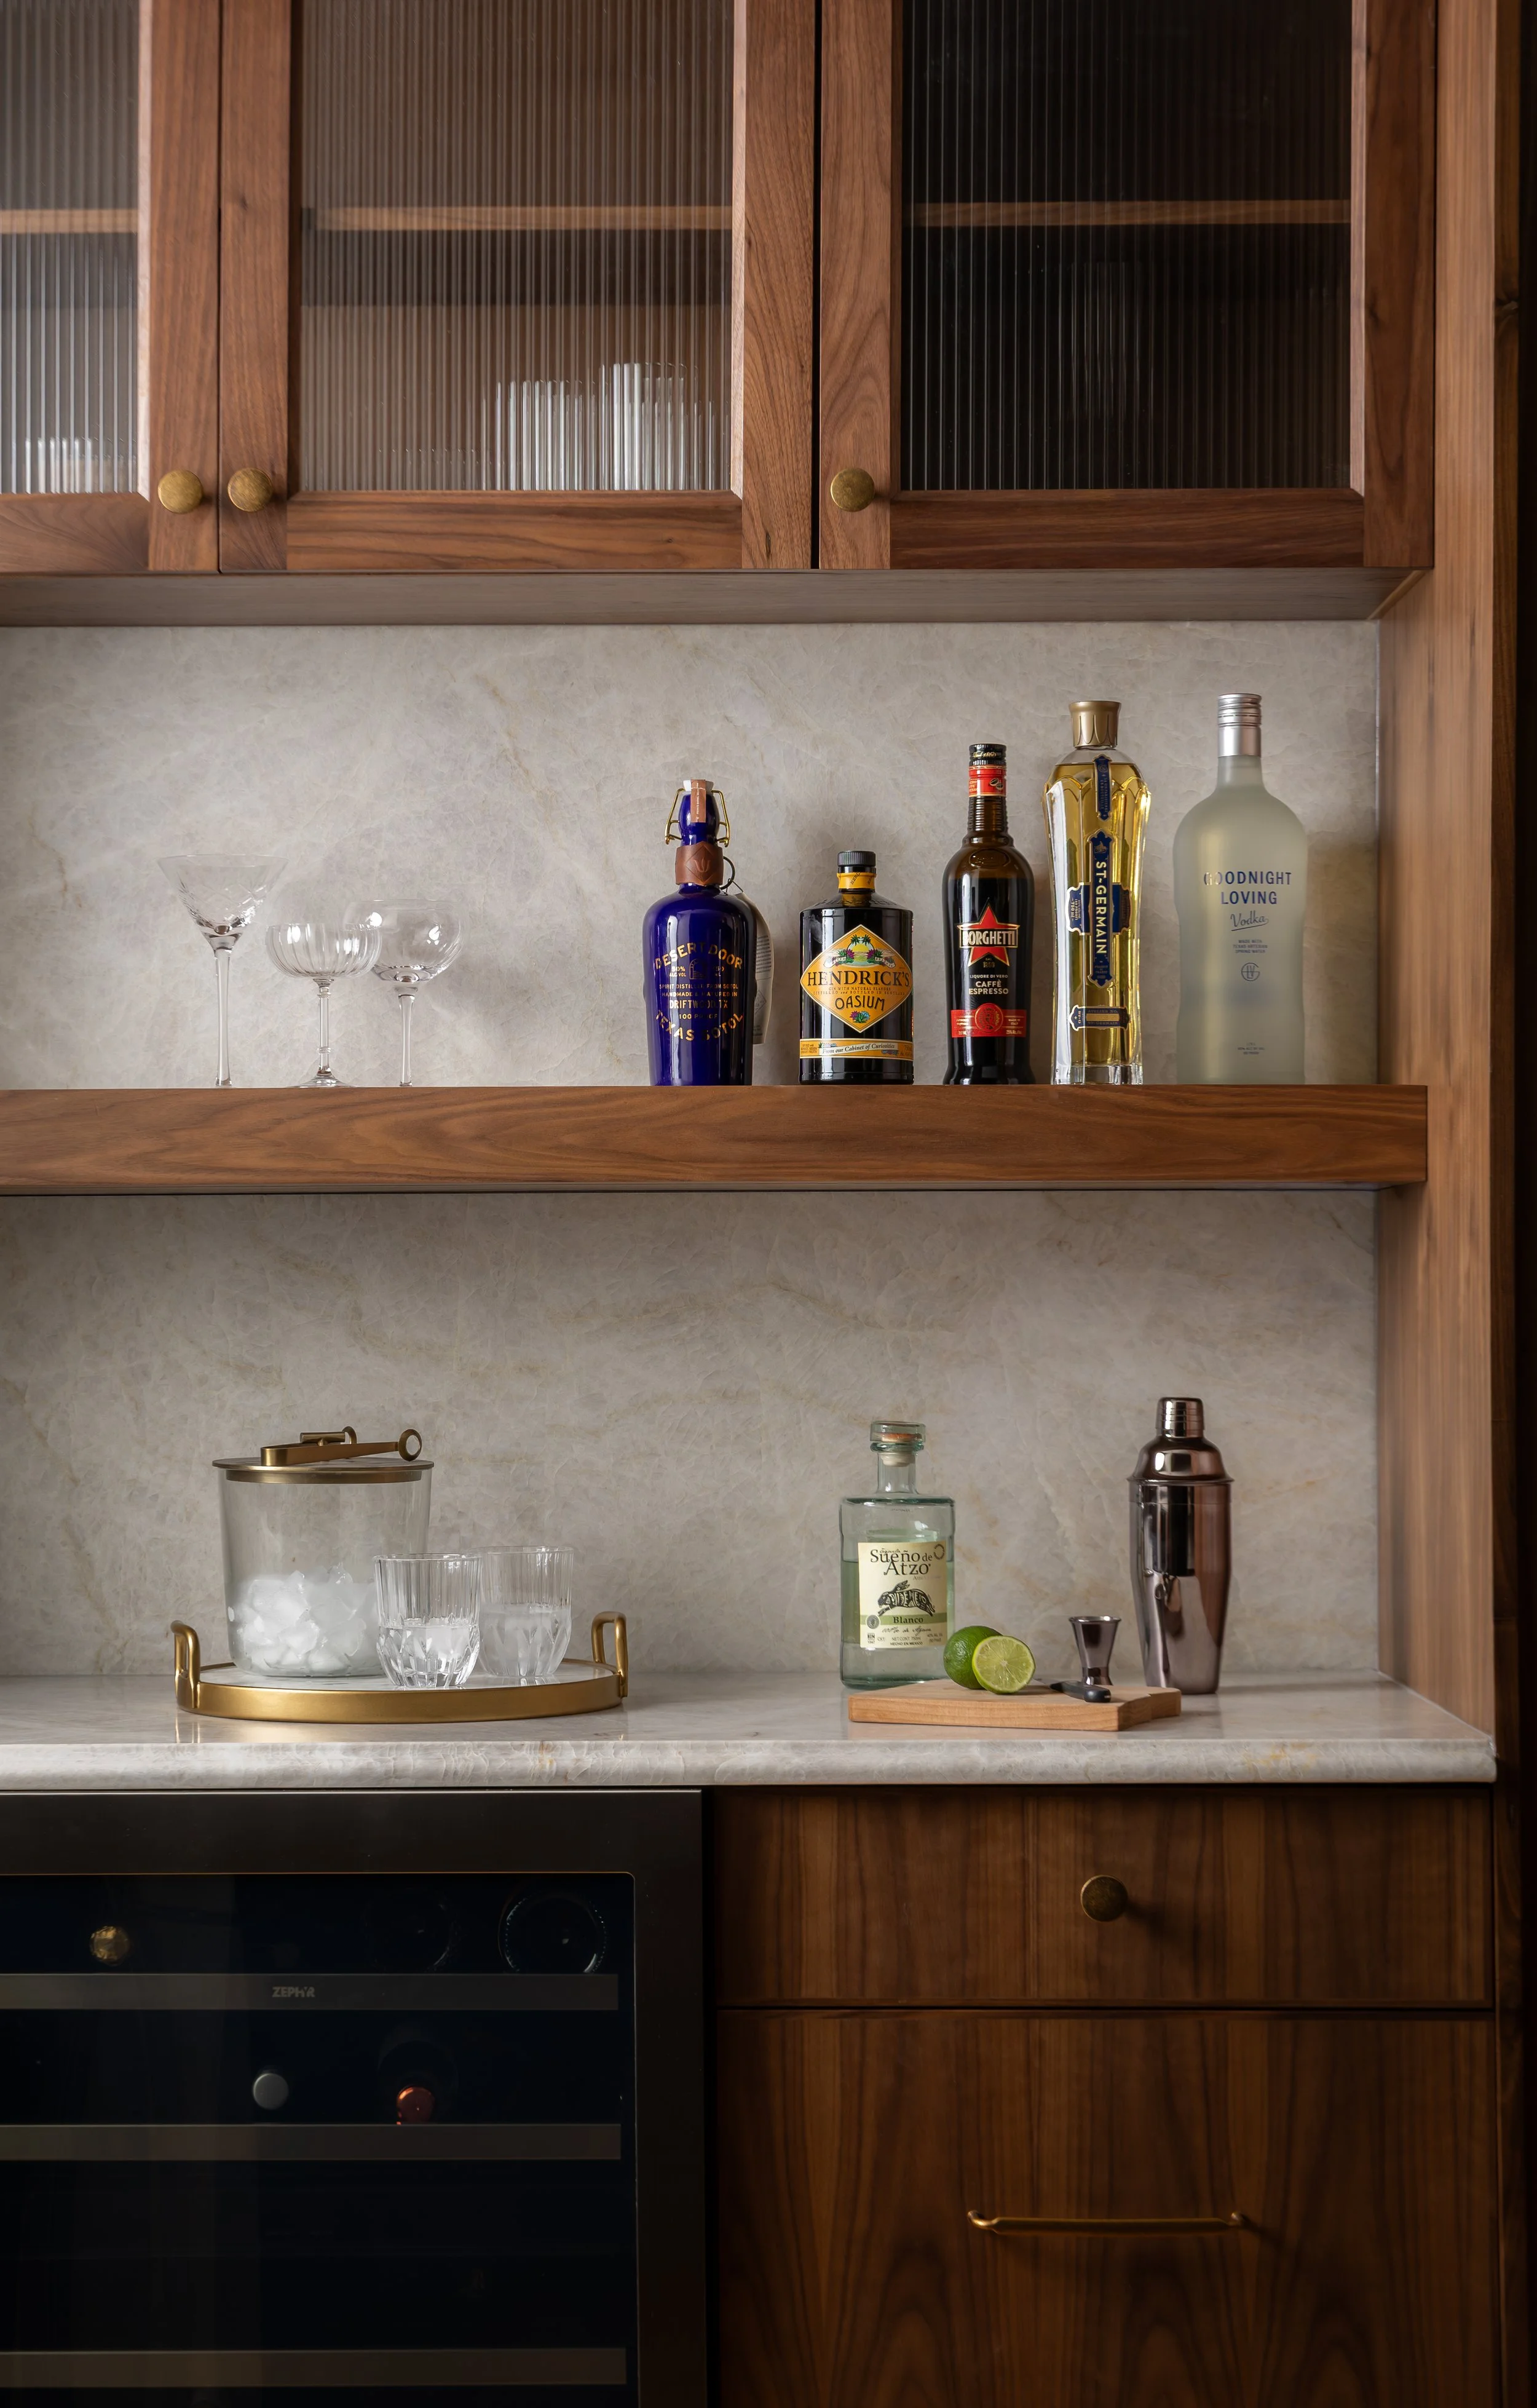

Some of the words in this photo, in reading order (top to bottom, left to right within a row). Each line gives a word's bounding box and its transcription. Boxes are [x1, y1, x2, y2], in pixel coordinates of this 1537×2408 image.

[1204, 871, 1291, 885] GOODNIGHT
[1221, 891, 1277, 905] LOVING
[1230, 910, 1267, 928] Vodka
[962, 930, 1015, 945] BORGHETTI
[655, 942, 705, 969] DESERT
[708, 944, 743, 969] DOOR
[807, 970, 911, 987] HENDRICK'S
[975, 979, 1002, 988] CAFFÈ
[835, 995, 885, 1011] OASIUM
[870, 1549, 920, 1562] Sueño
[922, 1553, 933, 1561] de
[883, 1560, 930, 1575] Atzo
